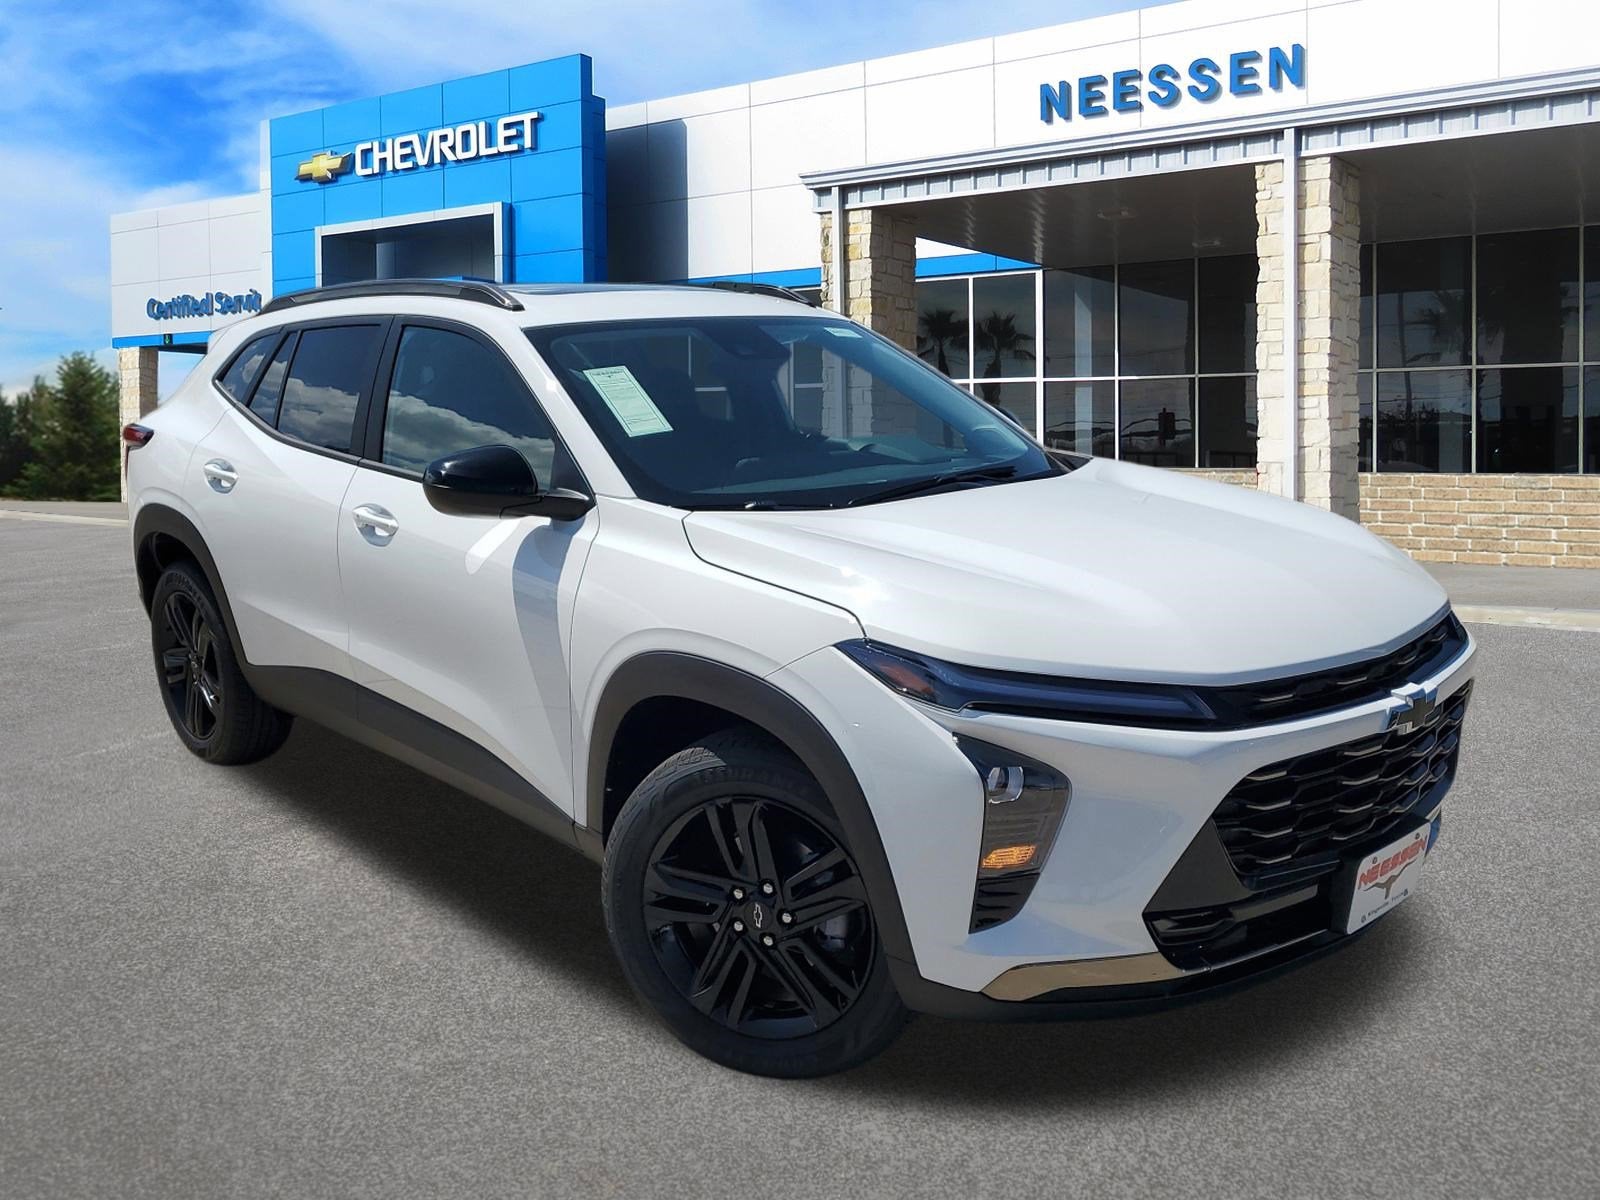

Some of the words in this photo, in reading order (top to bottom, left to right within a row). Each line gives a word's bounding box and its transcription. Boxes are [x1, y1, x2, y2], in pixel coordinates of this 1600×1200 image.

[1040, 43, 1306, 125] NEESSEN
[355, 111, 544, 178] CHEVROLET
[146, 292, 214, 320] Certified
[1358, 834, 1428, 890] NEESSEN
